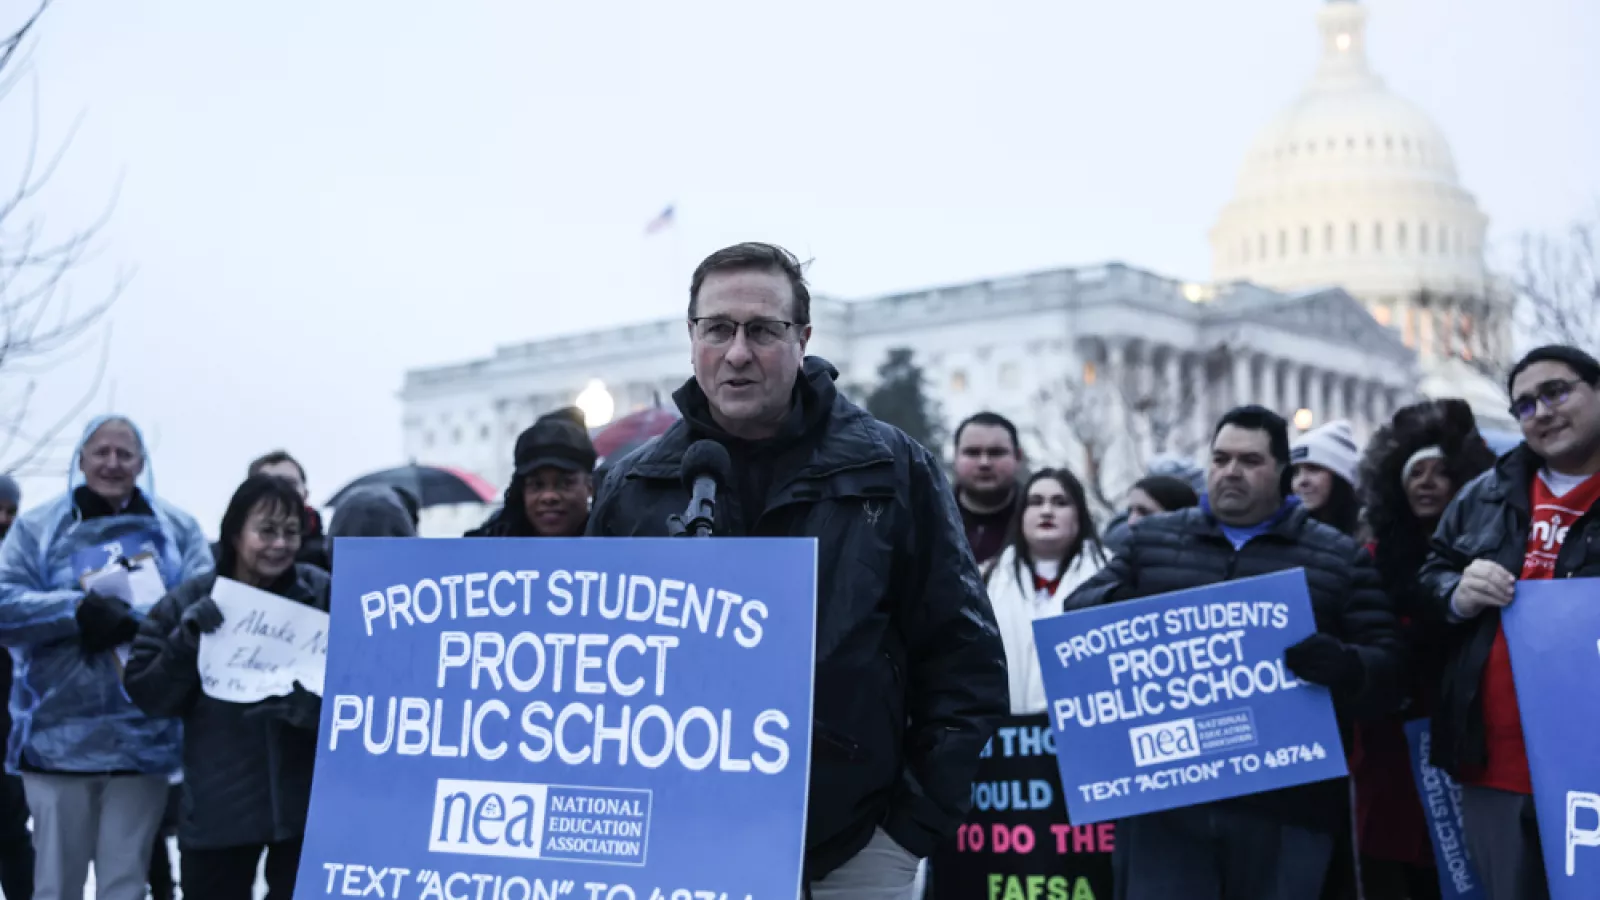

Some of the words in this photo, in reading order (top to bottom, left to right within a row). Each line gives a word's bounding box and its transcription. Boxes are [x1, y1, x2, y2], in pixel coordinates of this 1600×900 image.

[361, 570, 538, 636] PROTECT
[546, 570, 769, 648] STUDENTS
[1055, 613, 1160, 668] PROTECT
[1164, 602, 1289, 635] STUDENTS
[436, 631, 680, 697] PROTECT
[1108, 630, 1246, 685] PROTECT
[1054, 682, 1165, 732] PUBLIC
[1168, 658, 1309, 710] SCHOOL
[329, 695, 511, 760] PUBLIC
[518, 701, 791, 774] SCHOOLS
[1137, 726, 1195, 760] nea
[971, 779, 1054, 811] OULD
[1078, 776, 1131, 803] TEXT
[1229, 754, 1260, 775] TO
[1264, 742, 1327, 769] 48744
[437, 791, 535, 848] nea
[548, 817, 643, 837] EDUCATION
[551, 796, 644, 816] NATIONAL
[546, 837, 640, 856] ASSOCIATION
[991, 823, 1035, 854] DO
[1050, 823, 1116, 853] THE
[1433, 820, 1474, 894] PROTECT
[323, 863, 411, 899] TEXT
[987, 873, 1096, 900] FAFSA
